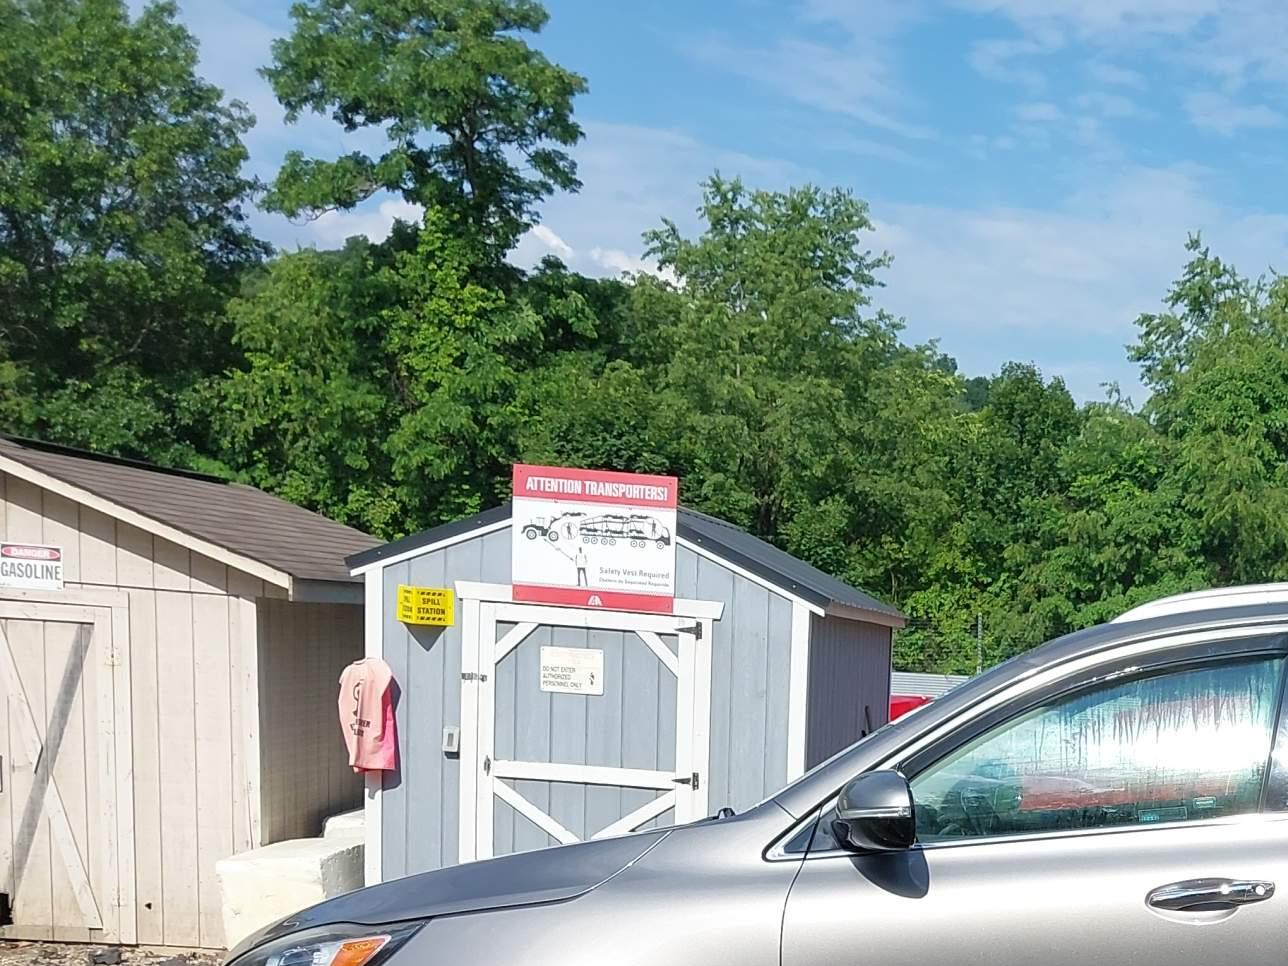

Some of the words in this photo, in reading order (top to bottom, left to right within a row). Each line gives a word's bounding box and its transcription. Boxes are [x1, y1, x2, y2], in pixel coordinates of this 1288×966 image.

[526, 476, 582, 494] ATTENTION
[584, 480, 668, 501] TRANSPORTERS!
[1, 561, 62, 580] GASOLINE
[599, 567, 621, 576] Safety
[622, 569, 637, 577] Vest
[639, 570, 670, 579] Required
[422, 597, 441, 606] SPILL
[417, 606, 446, 616] STATION
